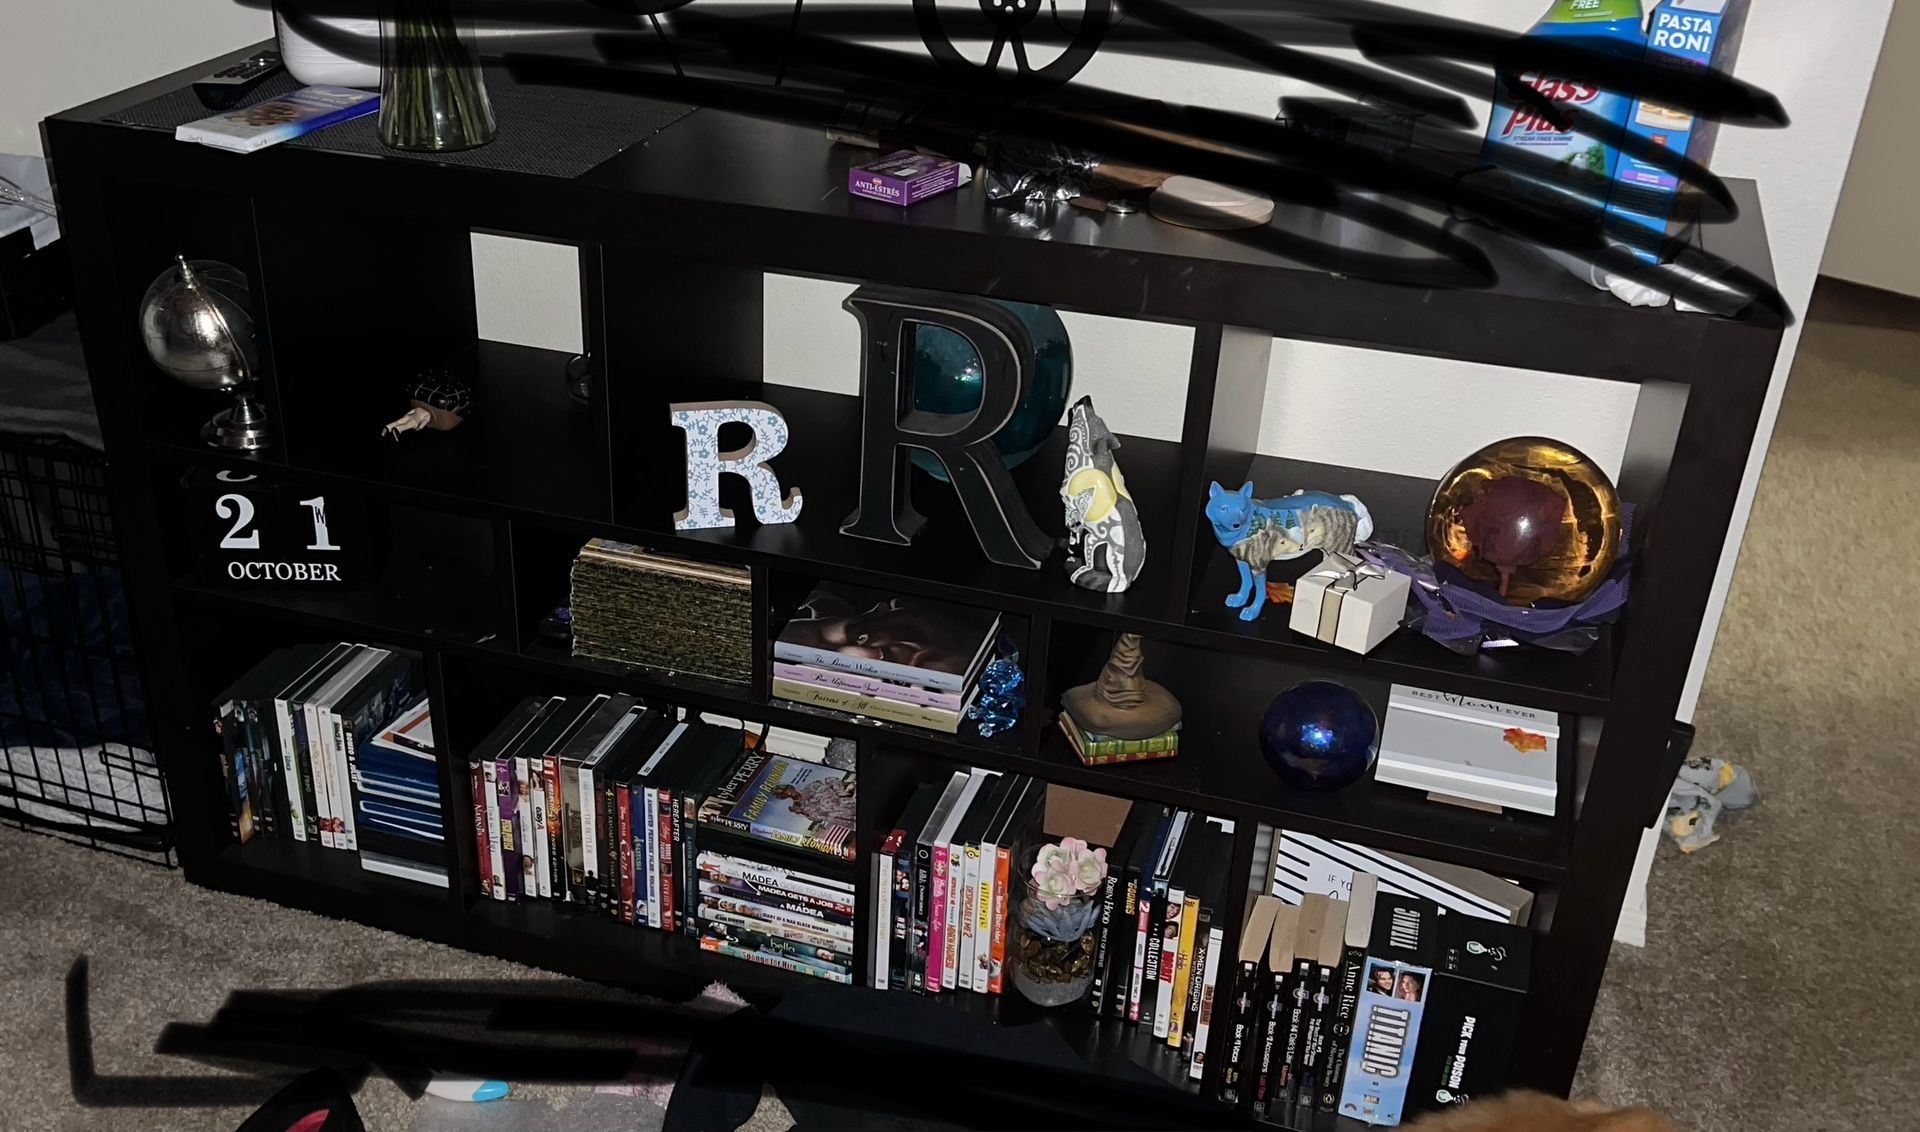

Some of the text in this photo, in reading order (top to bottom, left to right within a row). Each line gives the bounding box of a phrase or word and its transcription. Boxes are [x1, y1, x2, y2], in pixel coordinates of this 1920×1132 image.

[1658, 13, 1713, 34] PASTA
[1653, 29, 1710, 53] RONI
[1511, 70, 1600, 104] lass
[855, 180, 900, 197] ANTI-ESTRÉS
[839, 284, 1060, 571] R
[669, 400, 804, 530] R
[215, 493, 341, 550] 2 1
[227, 561, 342, 582] OCTOBER
[1411, 690, 1441, 700] BEST
[1505, 708, 1536, 718] EVER
[333, 722, 341, 739] SPACE
[345, 732, 354, 755] ROMEO
[349, 762, 358, 784] JULIET
[716, 751, 765, 799] tyler PERRY
[743, 759, 790, 820] FAMILY REUNION
[534, 806, 544, 824] easy
[672, 798, 680, 842] HEREAFTER
[711, 815, 749, 831] tyler PERRY
[549, 823, 557, 856] TENDED
[772, 830, 801, 845] FAMILY
[551, 857, 559, 883] EDITION
[1328, 874, 1337, 884] IF
[742, 872, 833, 900] MADEA GOES TO JAIL
[758, 885, 786, 897] MADEA
[787, 892, 808, 903] GETS
[816, 898, 834, 909] JOB
[1104, 876, 1117, 900] ROBIN
[786, 903, 824, 917] MADEA
[964, 885, 974, 921] DESPICABLE
[1125, 882, 1137, 915] GOONIES
[1139, 901, 1151, 913] 2
[1101, 900, 1114, 925] HOOD
[797, 920, 811, 928] BLACK
[811, 924, 829, 933] WOMAN
[896, 916, 906, 940] RENT
[946, 924, 955, 943] MINION
[964, 923, 971, 932] ME
[1388, 907, 1423, 951] TITANIC
[770, 939, 796, 953] bella
[945, 944, 955, 969] MADNESS
[770, 958, 781, 967] for
[782, 961, 797, 971] Hire
[1146, 937, 1160, 980] COLLECTION
[1159, 951, 1175, 983] NORBIT
[1344, 961, 1361, 993] Anne
[1190, 976, 1203, 1012] ORIGINS
[1291, 1008, 1301, 1024] Book
[1339, 994, 1356, 1020] Rice
[1234, 1024, 1244, 1039] Book
[1267, 1021, 1276, 1035] Book
[1290, 1024, 1298, 1032] #4
[1459, 1015, 1476, 1039] PICK
[1361, 1004, 1410, 1078] TITANIC
[1456, 1039, 1468, 1055] YOUR
[1231, 1045, 1240, 1063] Voices
[1336, 1048, 1344, 1060] The
[1446, 1054, 1467, 1090] POISON
